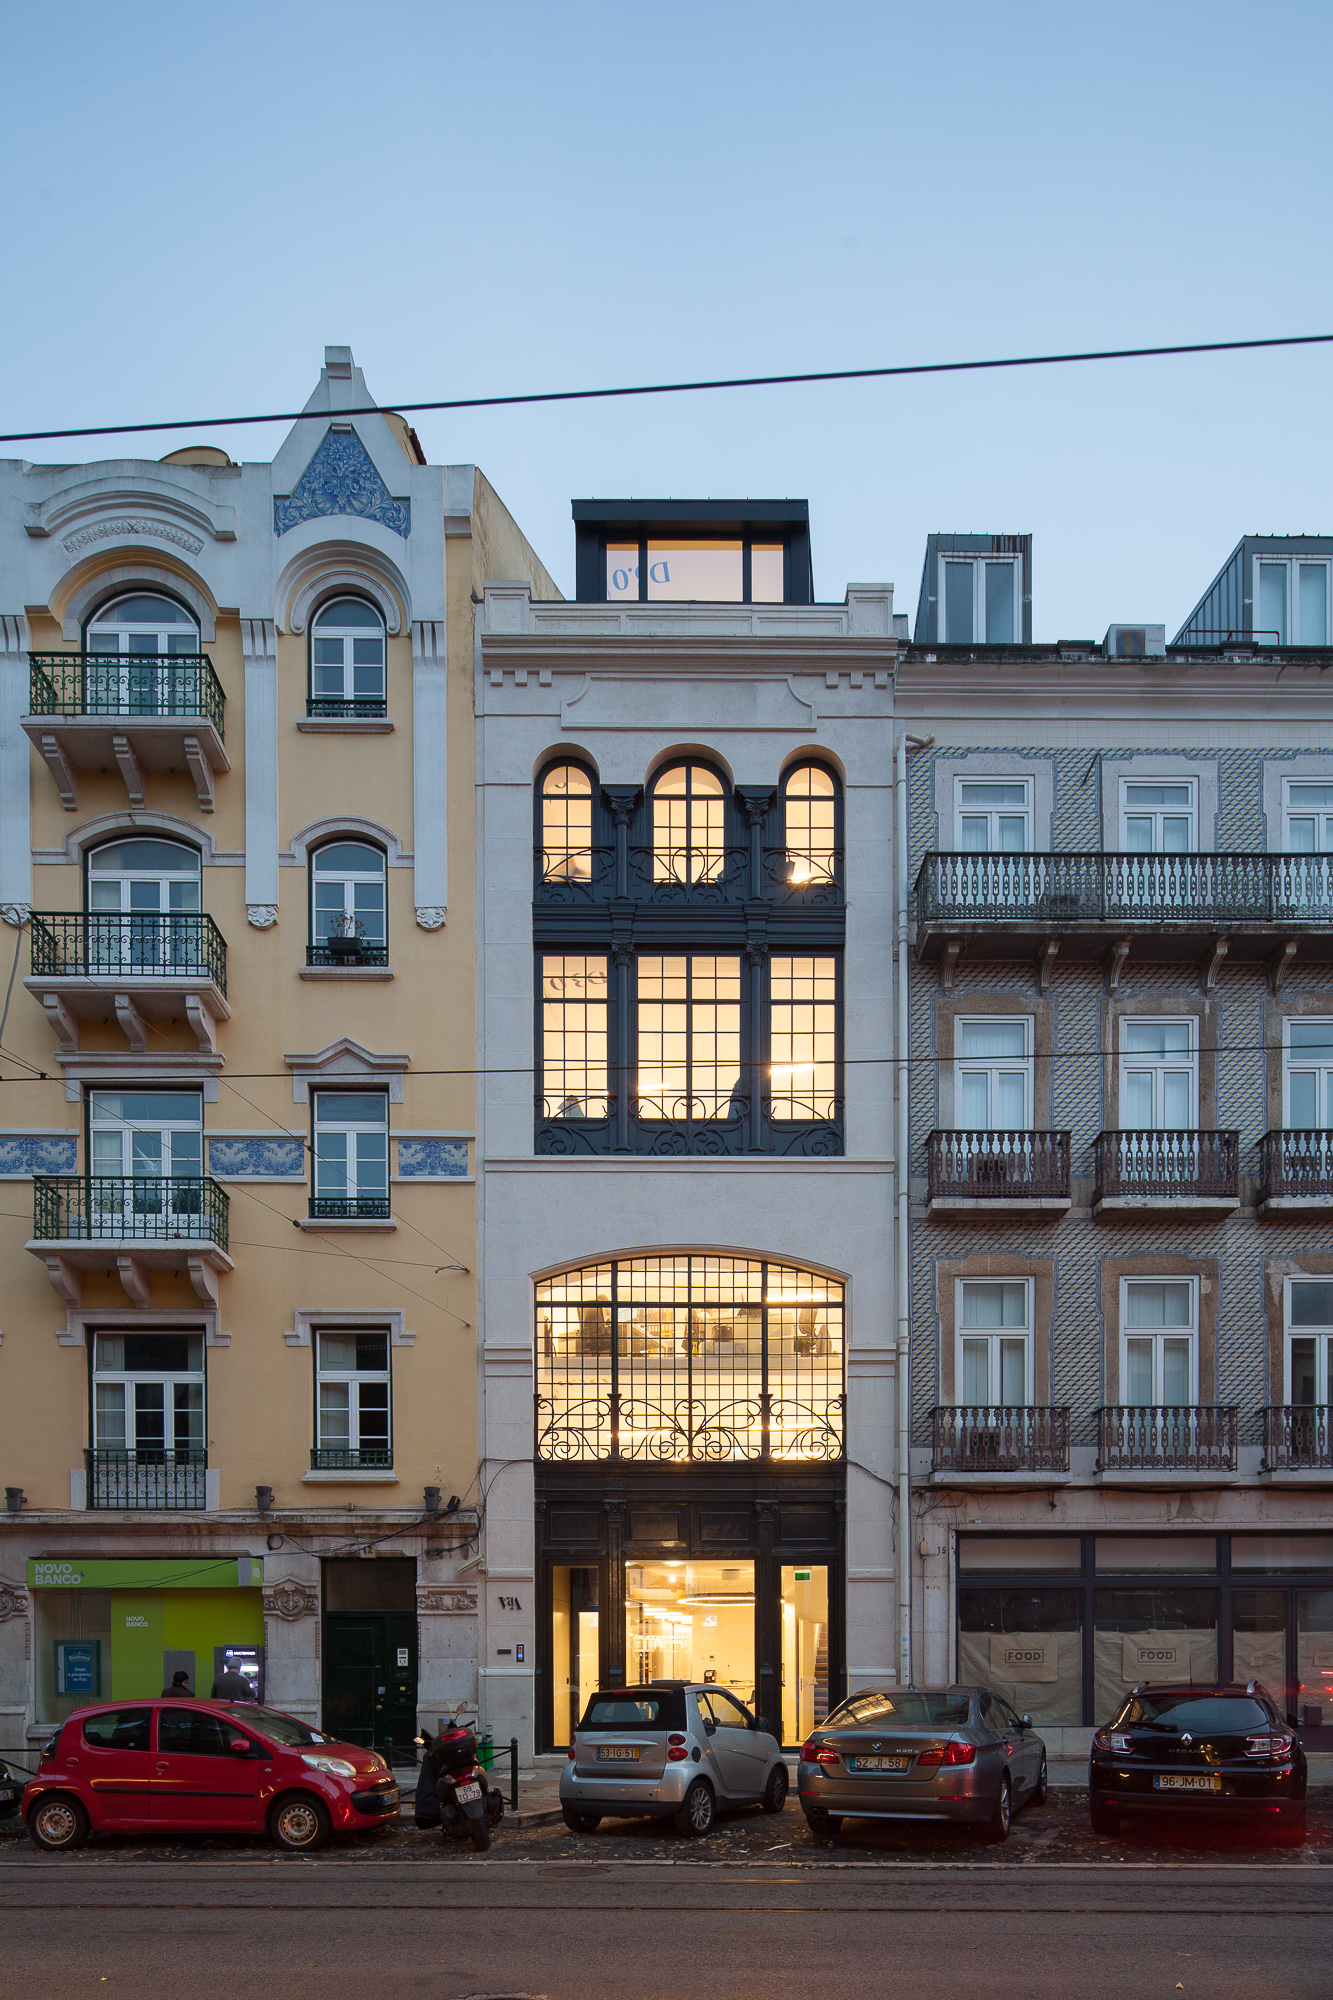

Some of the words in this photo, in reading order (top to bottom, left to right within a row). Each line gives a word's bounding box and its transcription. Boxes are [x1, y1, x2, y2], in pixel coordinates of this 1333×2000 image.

[937, 1546, 947, 1555] 15
[34, 1563, 72, 1574] NOVO
[252, 1567, 260, 1578] NB
[34, 1574, 81, 1585] BANCO
[1008, 1652, 1041, 1661] FOOD
[1140, 1651, 1173, 1660] FOOD
